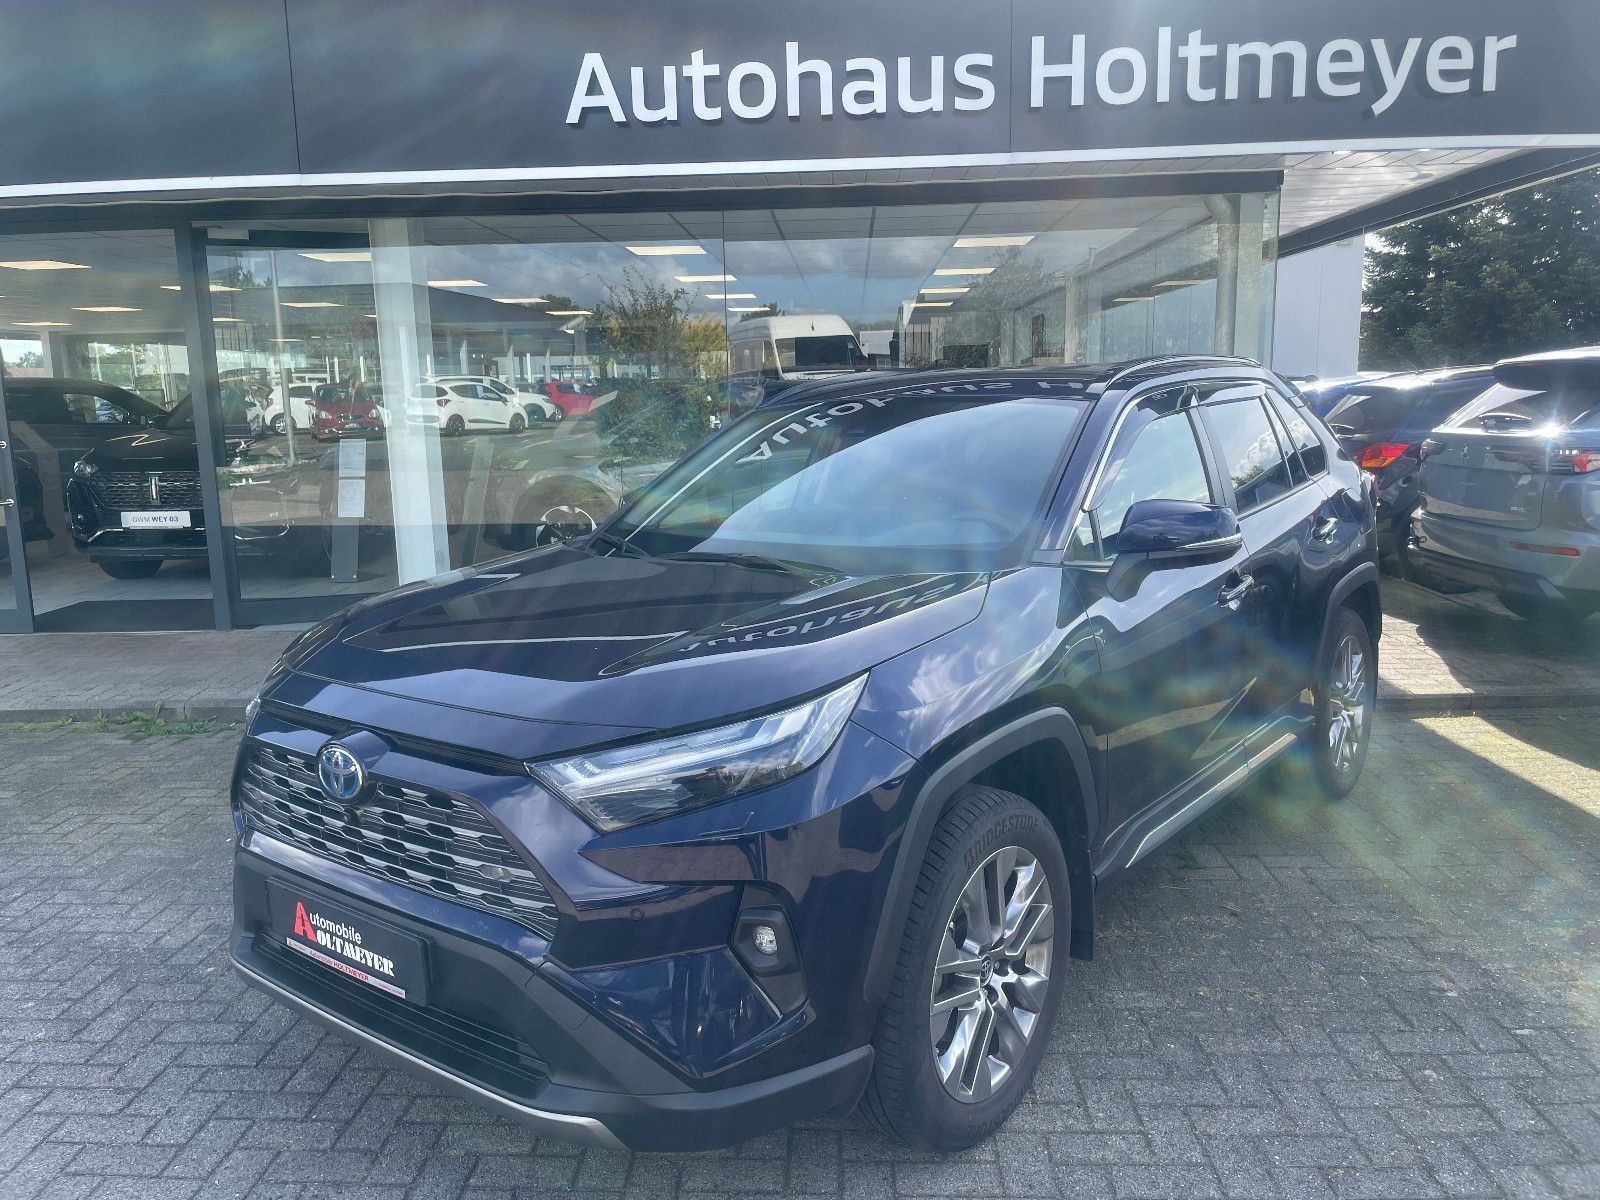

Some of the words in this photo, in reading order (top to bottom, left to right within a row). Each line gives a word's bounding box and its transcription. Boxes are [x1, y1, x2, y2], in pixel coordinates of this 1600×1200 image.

[565, 42, 995, 125] Autohaus
[1028, 26, 1519, 118] Holtmeyer
[294, 901, 362, 945] Automobile
[333, 960, 369, 982] HOLTMEYER
